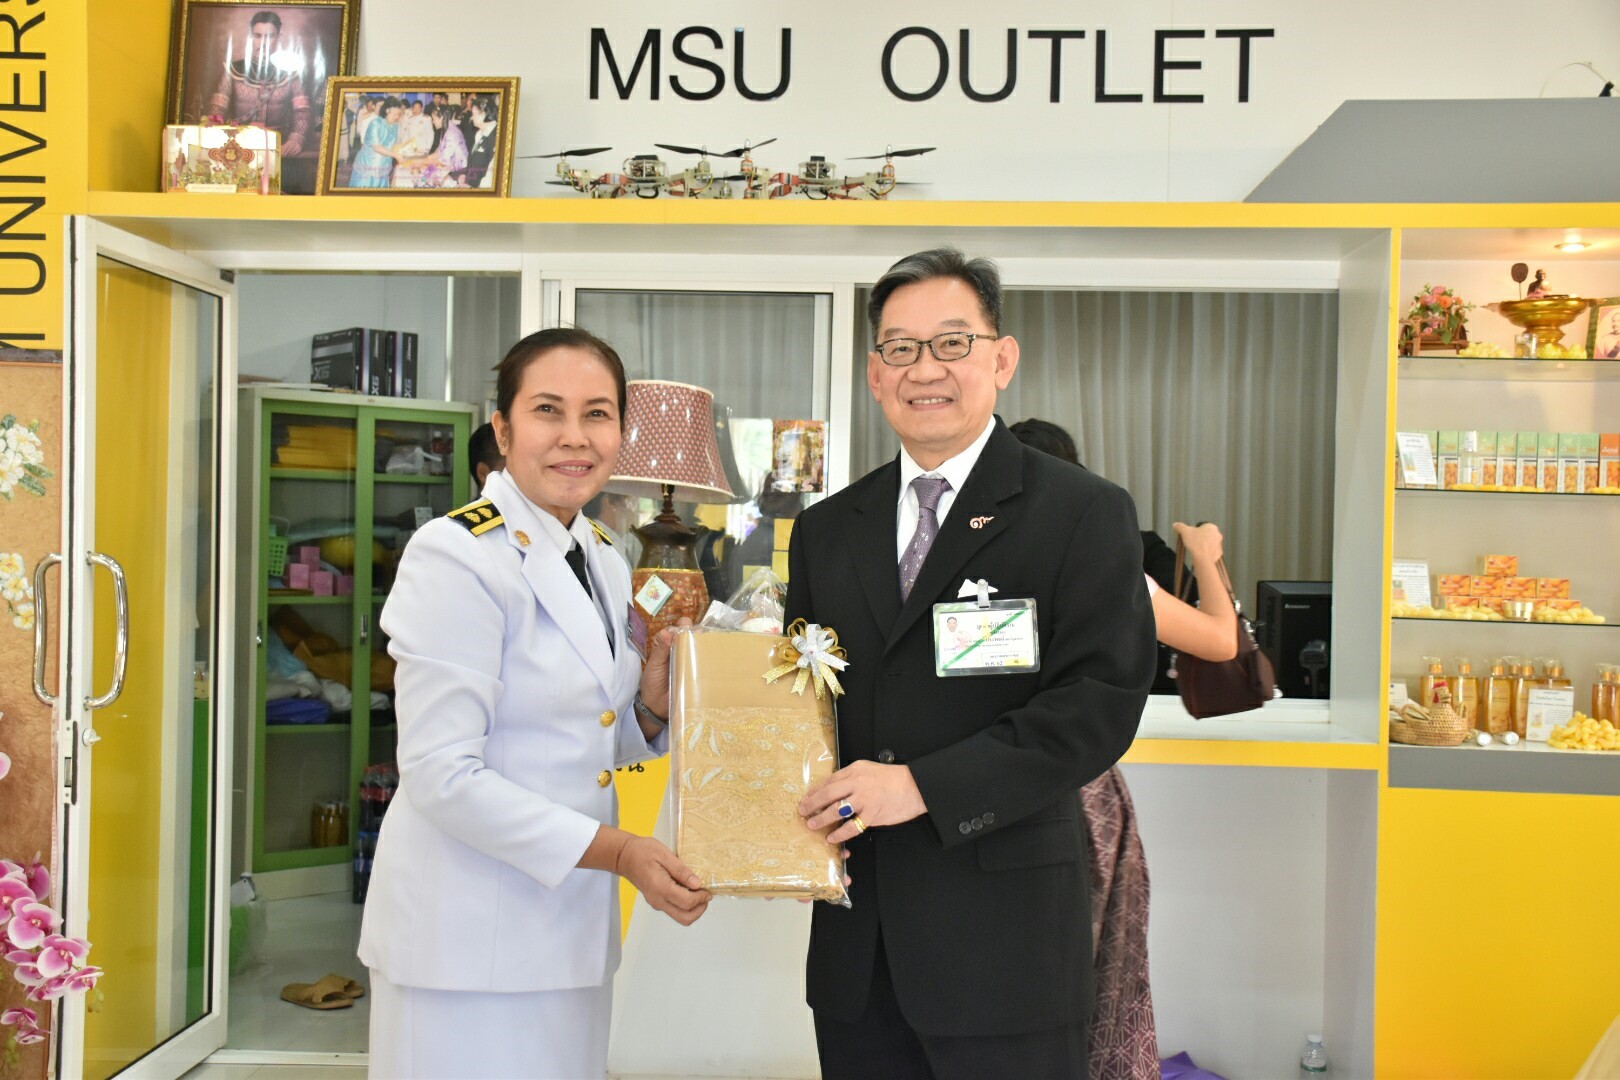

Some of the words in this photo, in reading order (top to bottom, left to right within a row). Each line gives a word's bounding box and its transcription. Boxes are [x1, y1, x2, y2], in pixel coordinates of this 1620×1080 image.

[0, 0, 47, 296] UNIVER
[589, 26, 792, 102] MSU
[881, 27, 1275, 104] OUTLET
